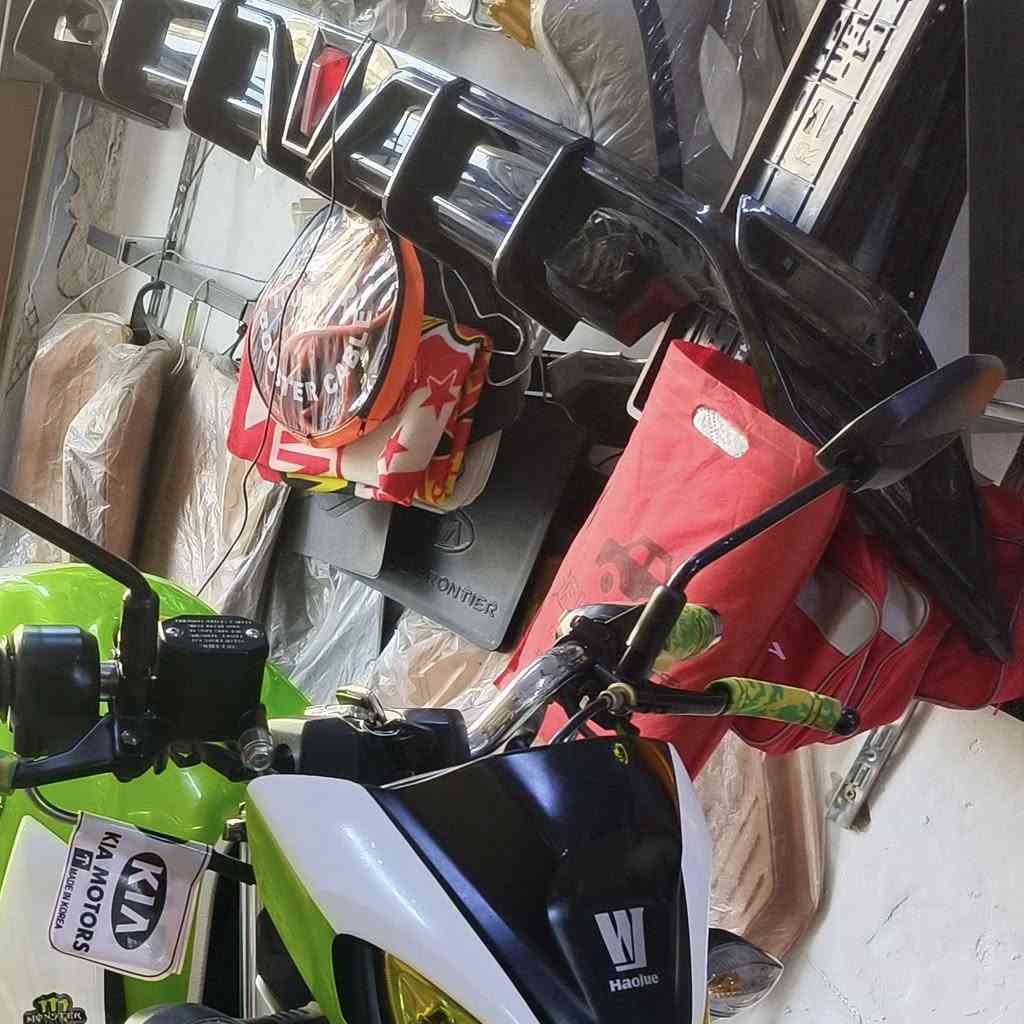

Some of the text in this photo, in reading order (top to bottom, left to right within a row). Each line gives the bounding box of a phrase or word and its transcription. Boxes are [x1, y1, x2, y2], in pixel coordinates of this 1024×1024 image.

[54, 868, 78, 930] MADE IN KOREA
[72, 831, 122, 954] KIA MOTORS
[115, 859, 164, 933] KIA
[608, 972, 659, 993] HaoJue
